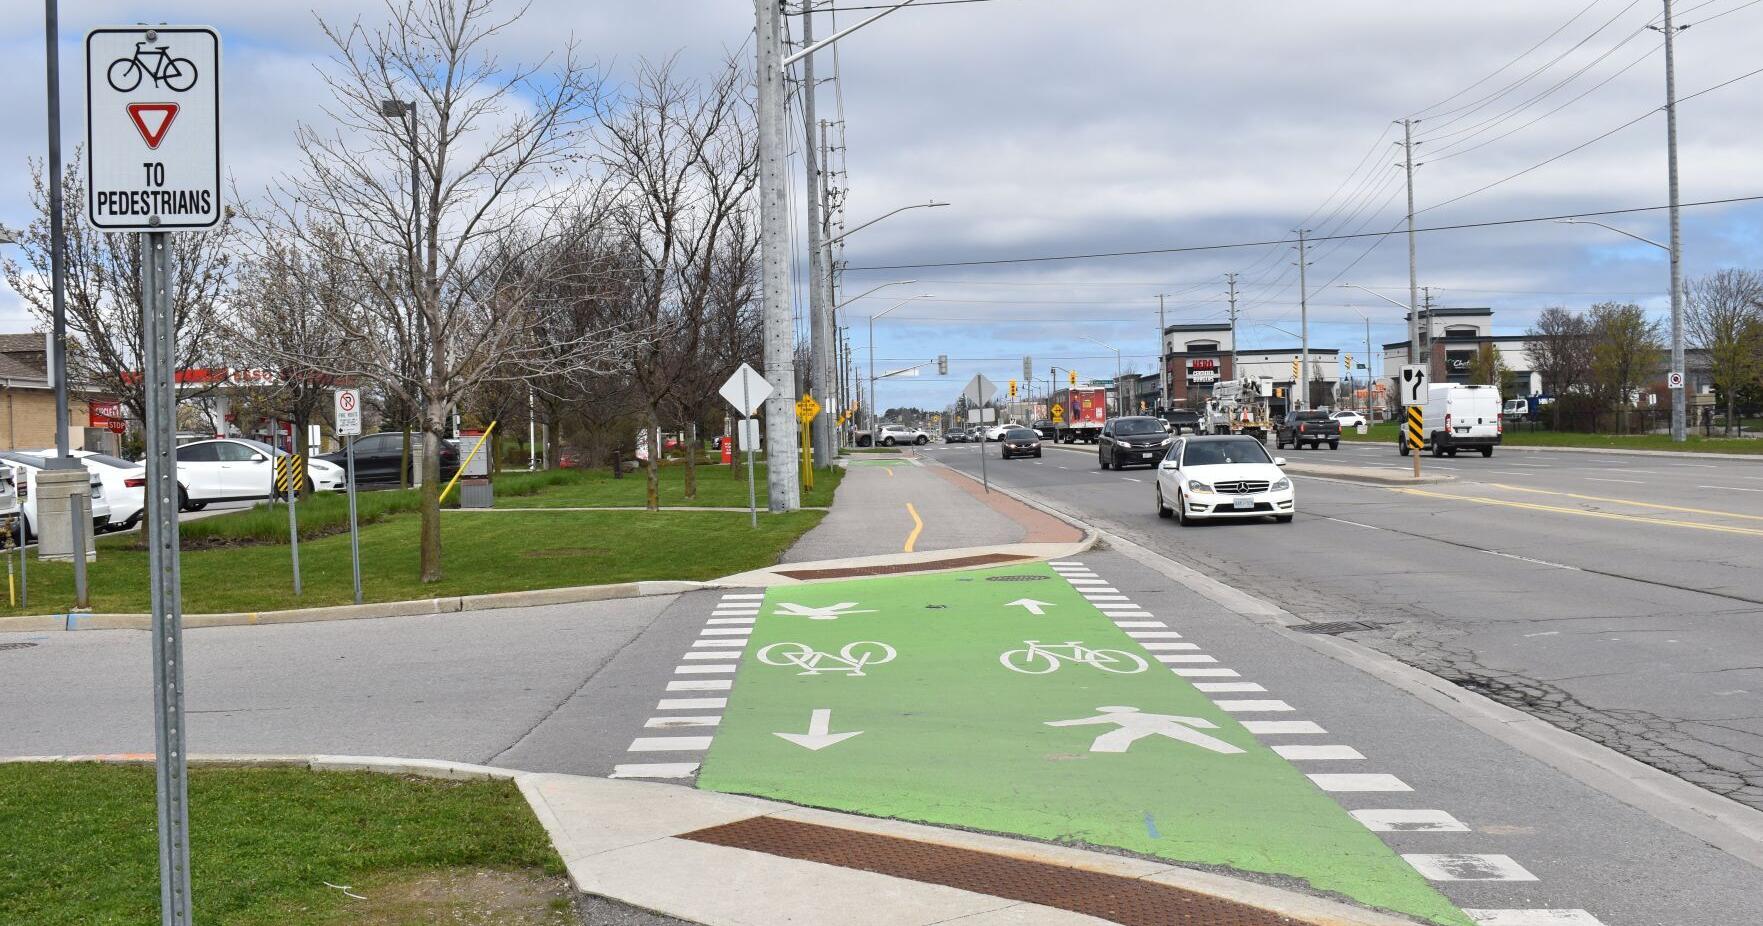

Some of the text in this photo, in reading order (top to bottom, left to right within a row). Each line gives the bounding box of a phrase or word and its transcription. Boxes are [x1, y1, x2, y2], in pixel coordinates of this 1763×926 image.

[143, 163, 164, 187] TO
[97, 190, 211, 215] PEDESTRIANS
[1192, 359, 1214, 368] HERO
[109, 421, 125, 429] STOP
